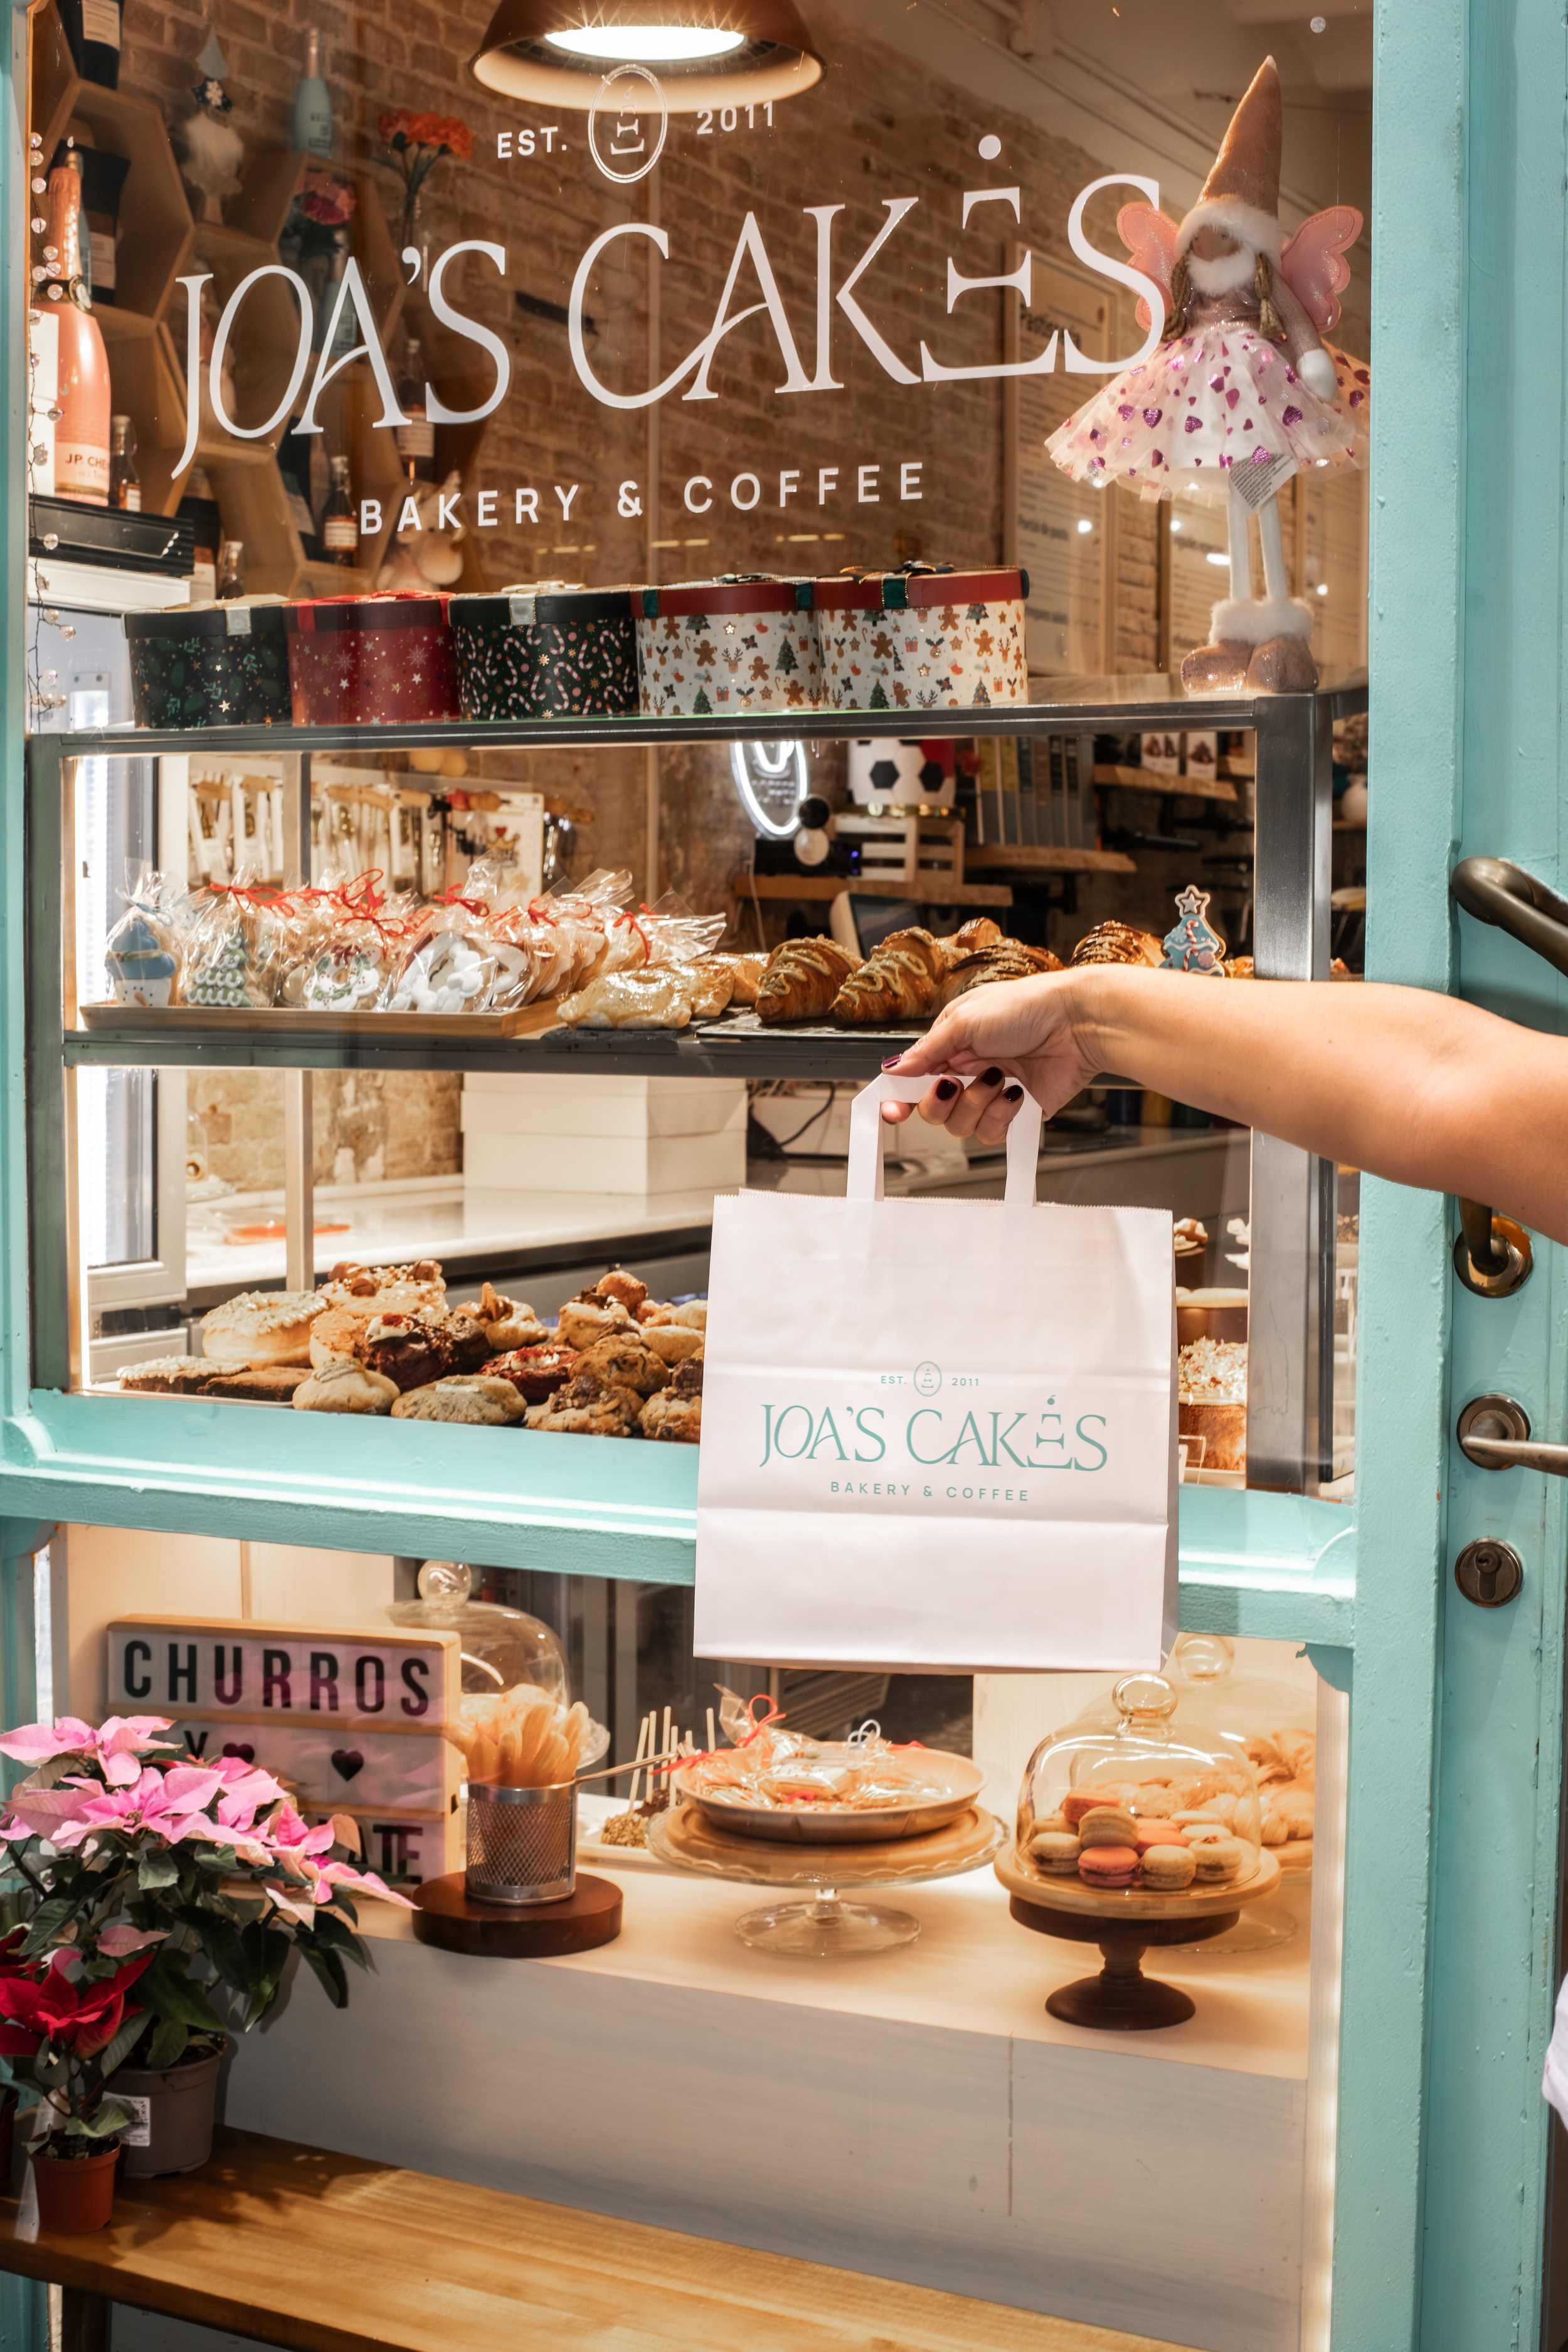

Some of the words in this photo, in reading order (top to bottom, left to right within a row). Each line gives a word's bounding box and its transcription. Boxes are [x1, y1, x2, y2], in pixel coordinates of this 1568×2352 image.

[497, 127, 567, 158] EST.
[697, 101, 776, 135] 2011
[171, 240, 511, 479] JOA'S
[361, 484, 580, 534] BAKERY
[617, 481, 643, 517] &
[684, 463, 923, 513] COFFEE
[881, 1375, 907, 1385] EST.
[951, 1377, 980, 1387] 2011
[759, 1404, 886, 1469] JOA'S
[830, 1481, 911, 1496] BAKERY
[923, 1485, 933, 1496] &
[946, 1485, 1029, 1502] COFFEE
[124, 1640, 430, 1717] CHURROS
